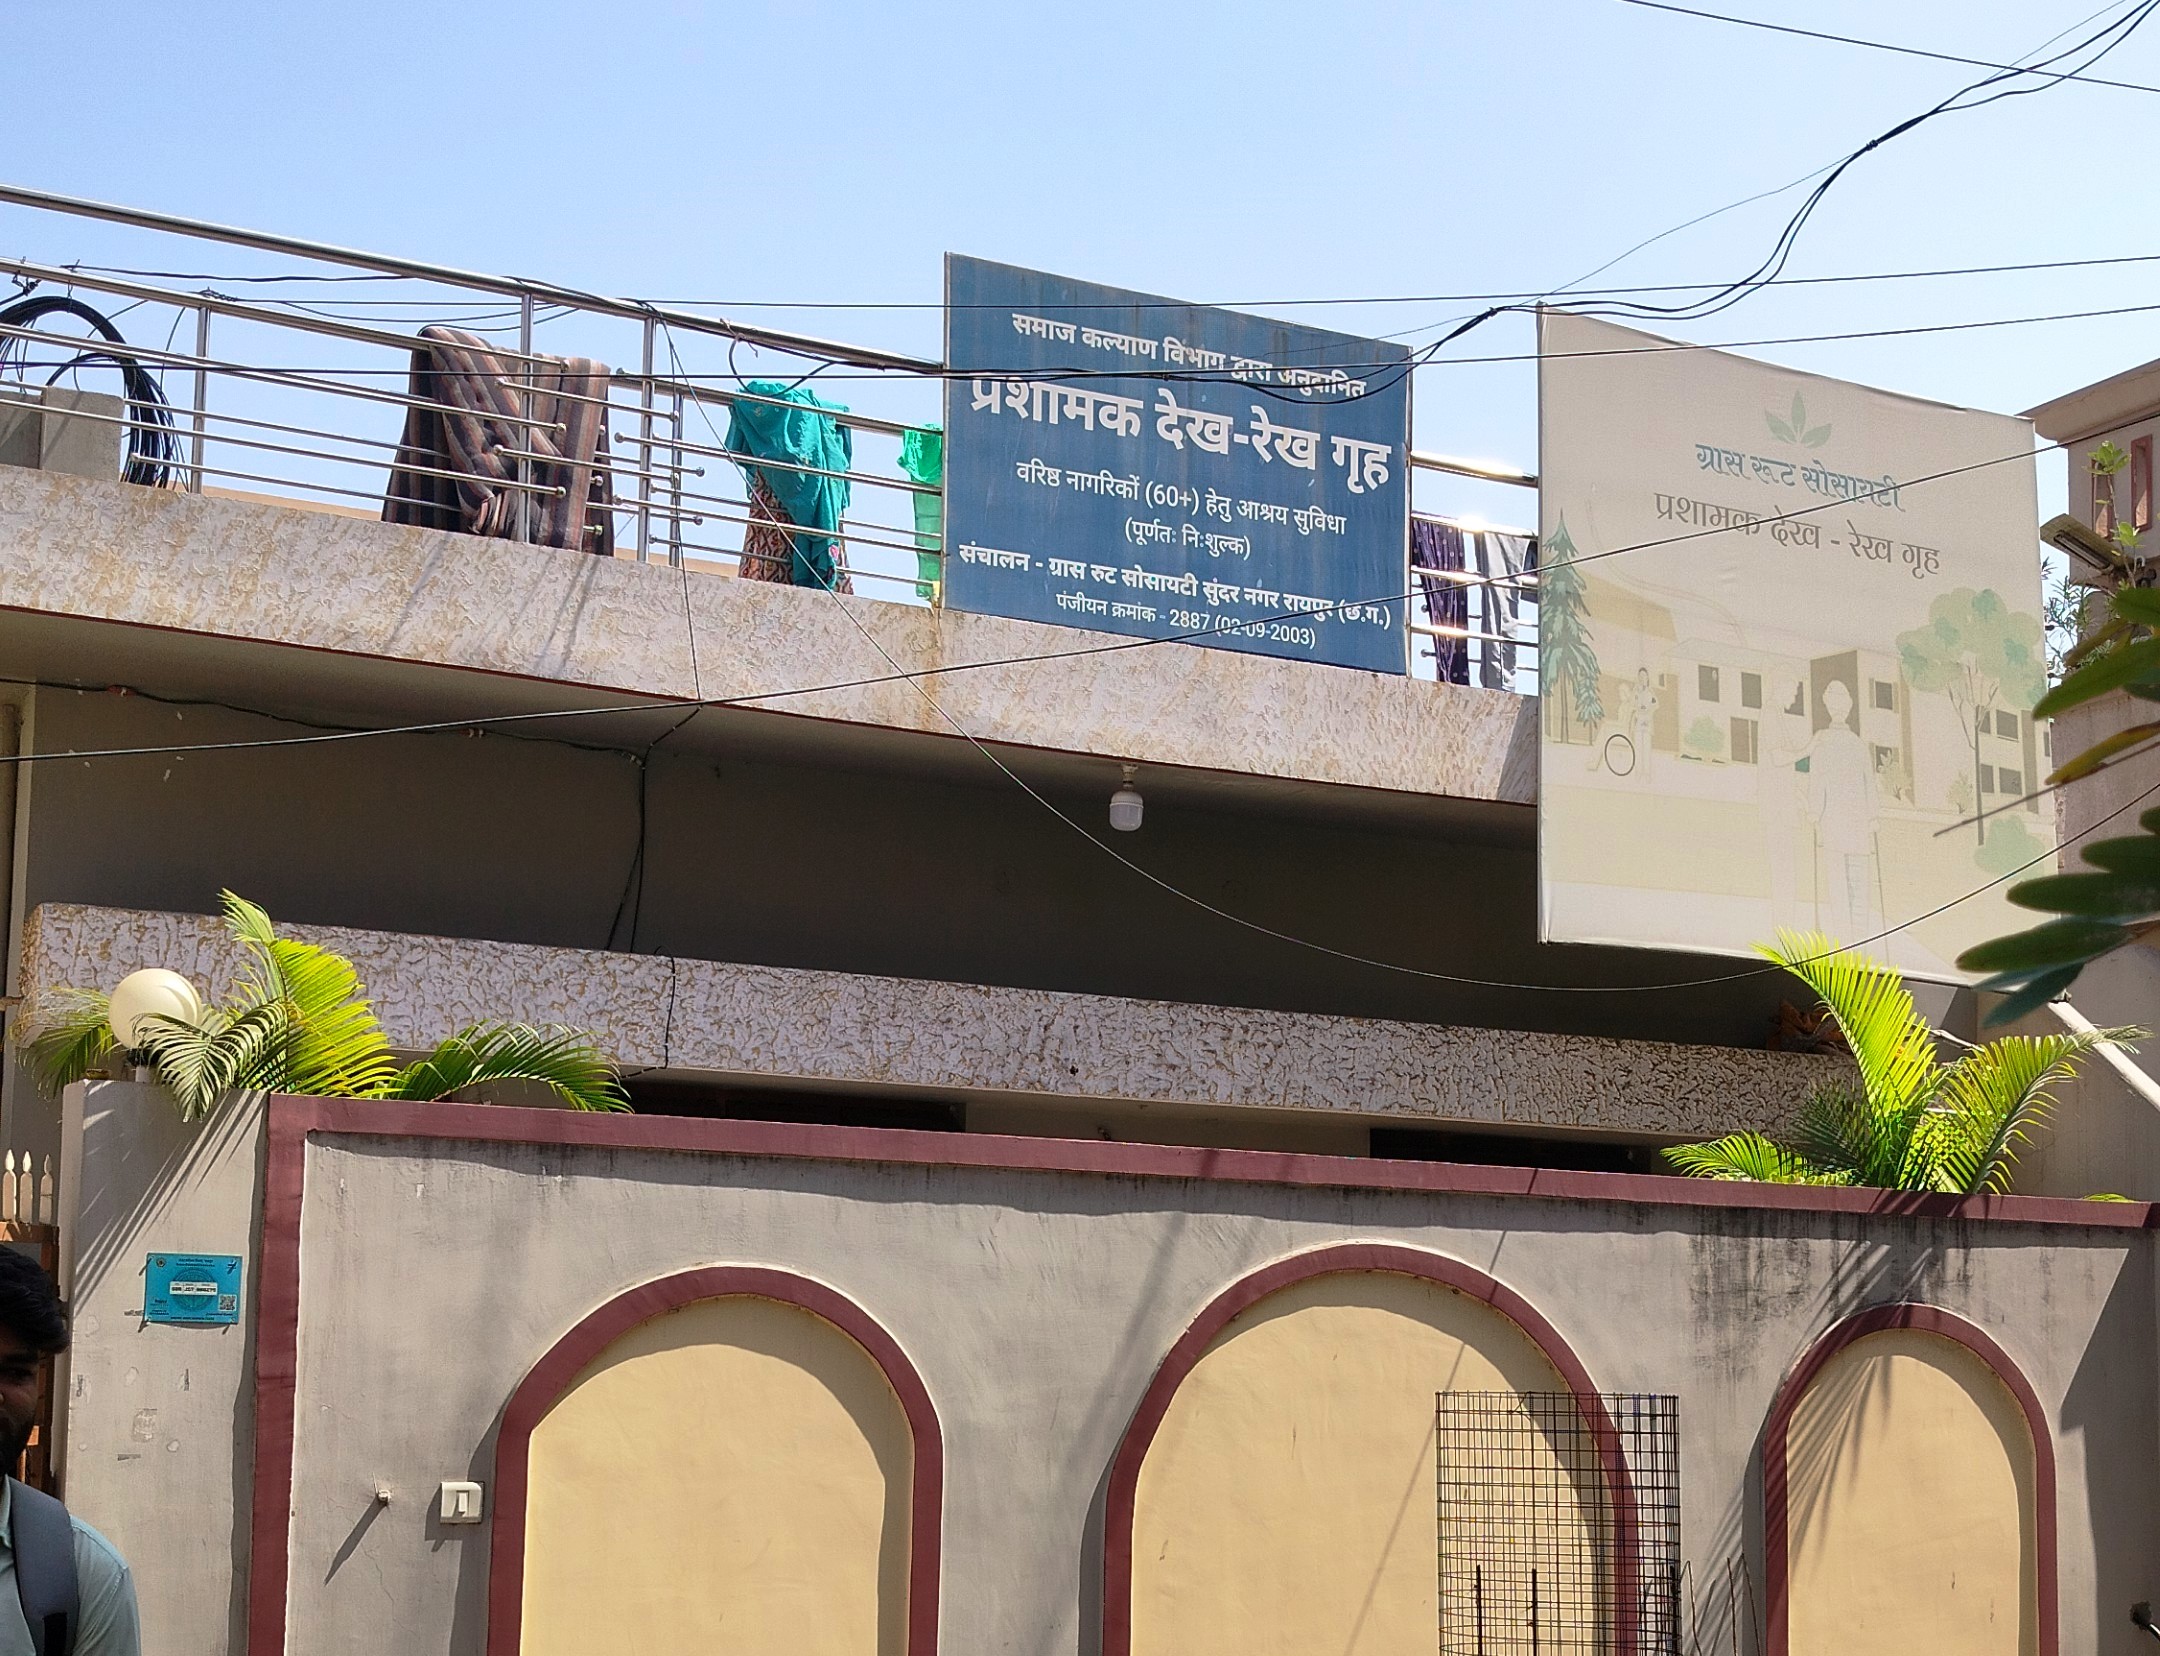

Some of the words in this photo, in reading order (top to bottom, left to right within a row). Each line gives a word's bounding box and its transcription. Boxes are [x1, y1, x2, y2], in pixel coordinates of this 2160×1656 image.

[1012, 313, 1076, 343] समाज
[1082, 327, 1158, 360] कल्याण
[1231, 356, 1273, 382] द्वारा
[971, 372, 1143, 437] प्रशामक
[1155, 388, 1321, 470] देख-रेख
[1331, 436, 1392, 494] गृह
[1016, 457, 1062, 487] वरिष्ठ
[1066, 470, 1140, 500] नागरिकों
[1145, 481, 1200, 515] (60+)
[1204, 487, 1232, 523] हेतु
[1236, 500, 1289, 526] आश्रय
[1293, 505, 1347, 536] सुविधा
[1695, 443, 1750, 480] ग्रास
[1750, 455, 1797, 487] रूट
[1801, 458, 1906, 513] सोसायटी
[1653, 492, 1762, 536] प्रशामक
[1770, 504, 1822, 549] देख
[1847, 519, 1894, 563] रेख
[1901, 543, 1940, 580] गृह
[959, 541, 1031, 571] संचालन
[1049, 557, 1086, 580] ग्रास
[1090, 564, 1118, 585] रुट
[1121, 564, 1198, 597] सोसायटी
[1202, 577, 1240, 606] सुंदर
[1244, 587, 1280, 609] नगर
[1283, 593, 1334, 622] रायपुर
[1056, 591, 1108, 616] पंजीयन
[1112, 601, 1157, 623] क्रमांक
[1169, 608, 1210, 630] 2887
[1214, 614, 1317, 650] (02-09-2003)
